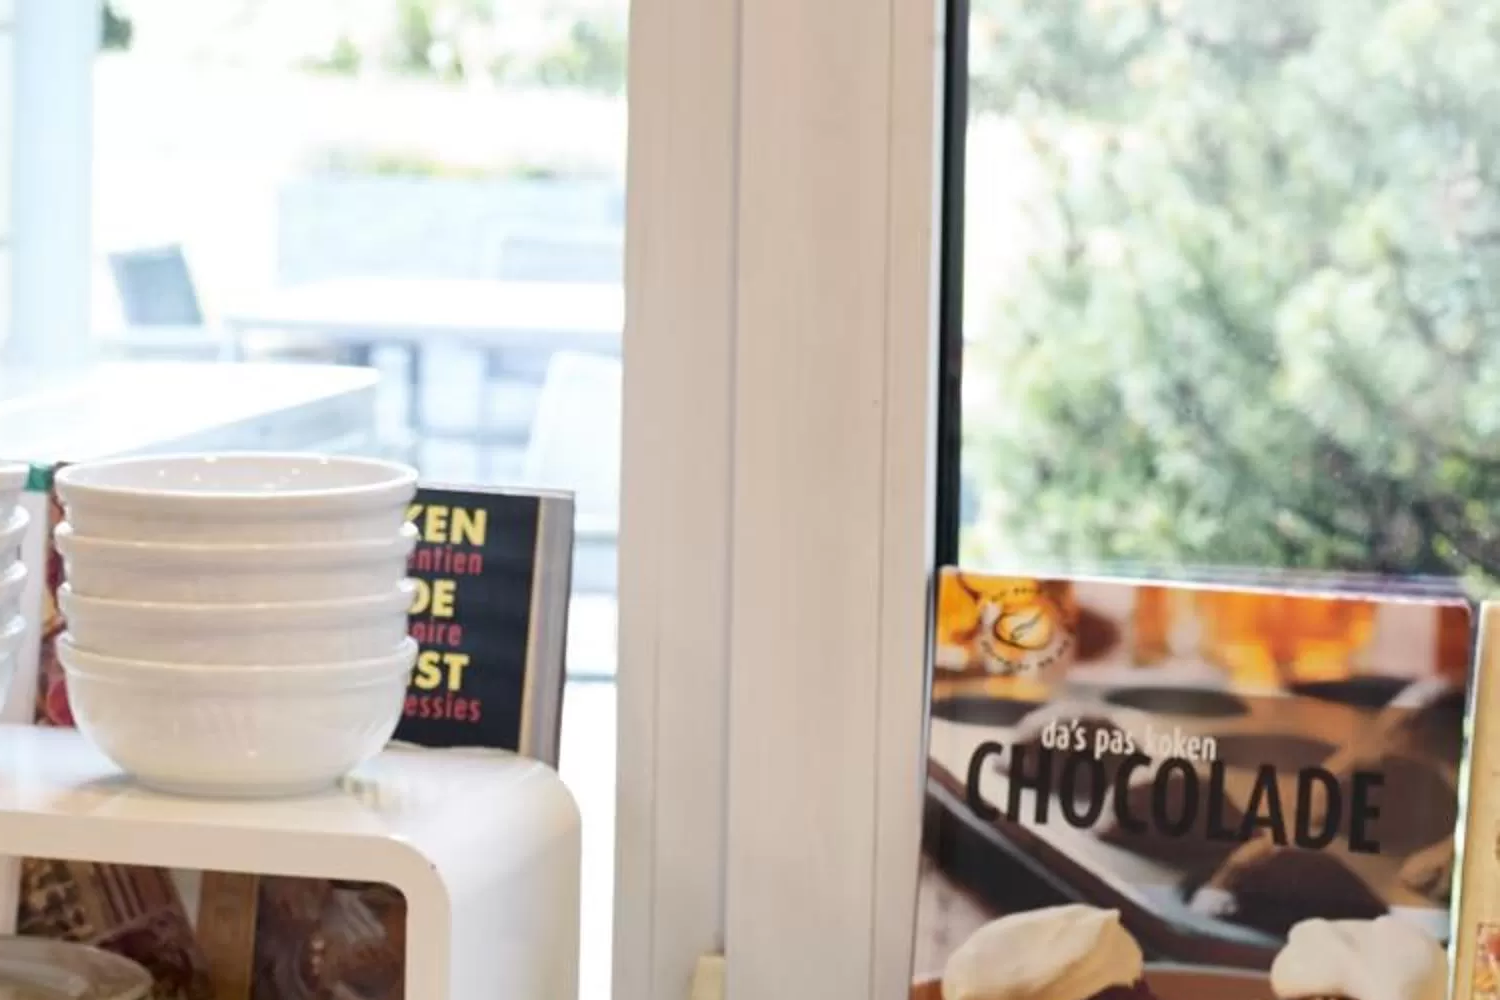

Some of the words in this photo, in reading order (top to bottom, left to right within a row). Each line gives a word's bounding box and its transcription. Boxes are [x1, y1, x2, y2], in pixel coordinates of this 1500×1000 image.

[1041, 720, 1087, 750] da's
[1094, 729, 1135, 760] pas
[1145, 725, 1217, 761] koken
[966, 741, 1385, 855] CHOCOLADE
